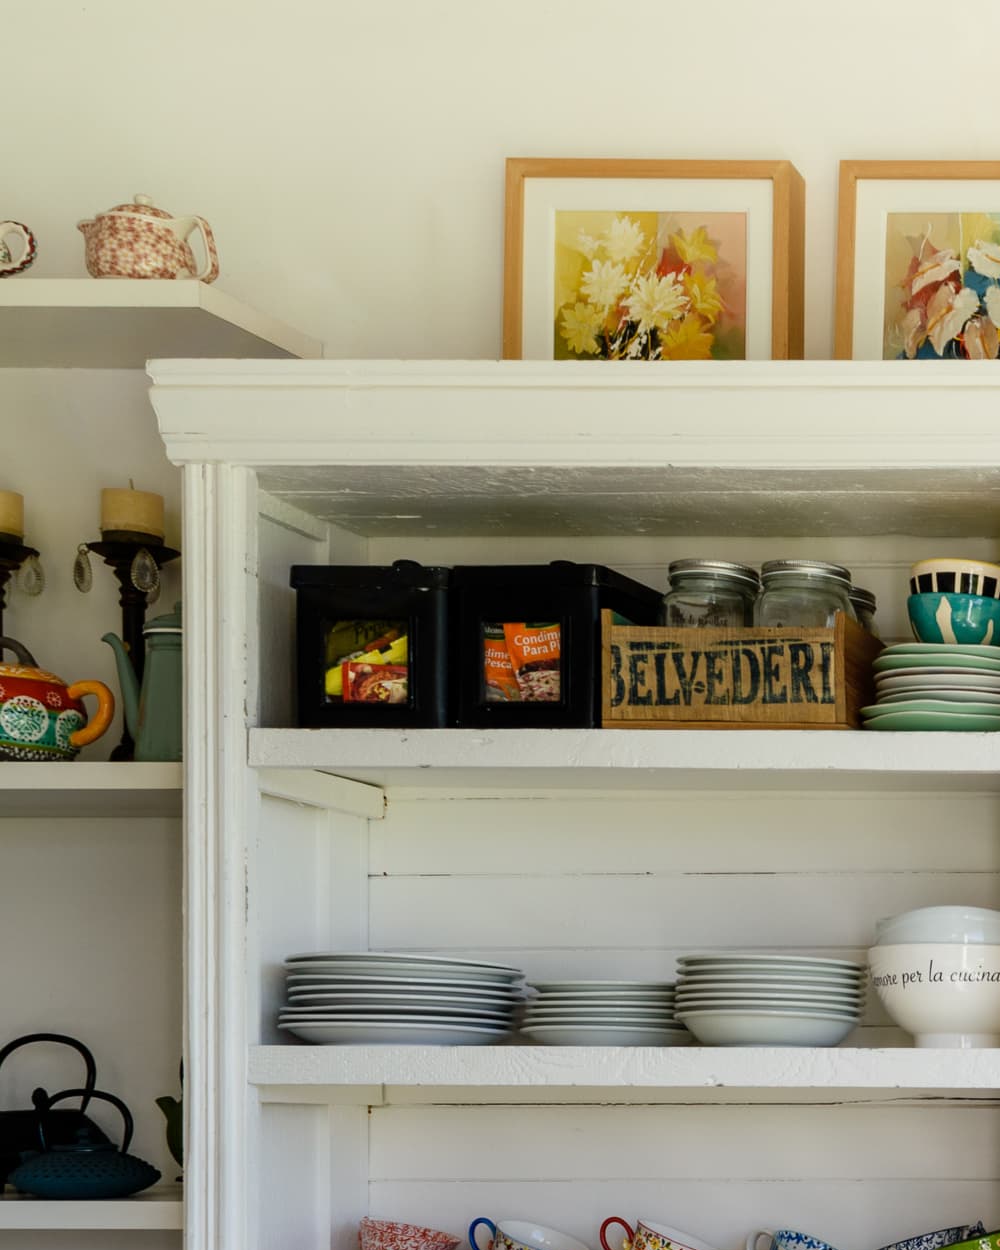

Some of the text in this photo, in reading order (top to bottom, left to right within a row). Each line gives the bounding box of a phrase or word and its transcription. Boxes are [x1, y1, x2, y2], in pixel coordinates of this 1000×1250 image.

[514, 631, 560, 646] Condim
[522, 644, 548, 656] Para
[901, 969, 923, 989] per
[928, 959, 944, 983] la
[950, 965, 1000, 983] cucina
